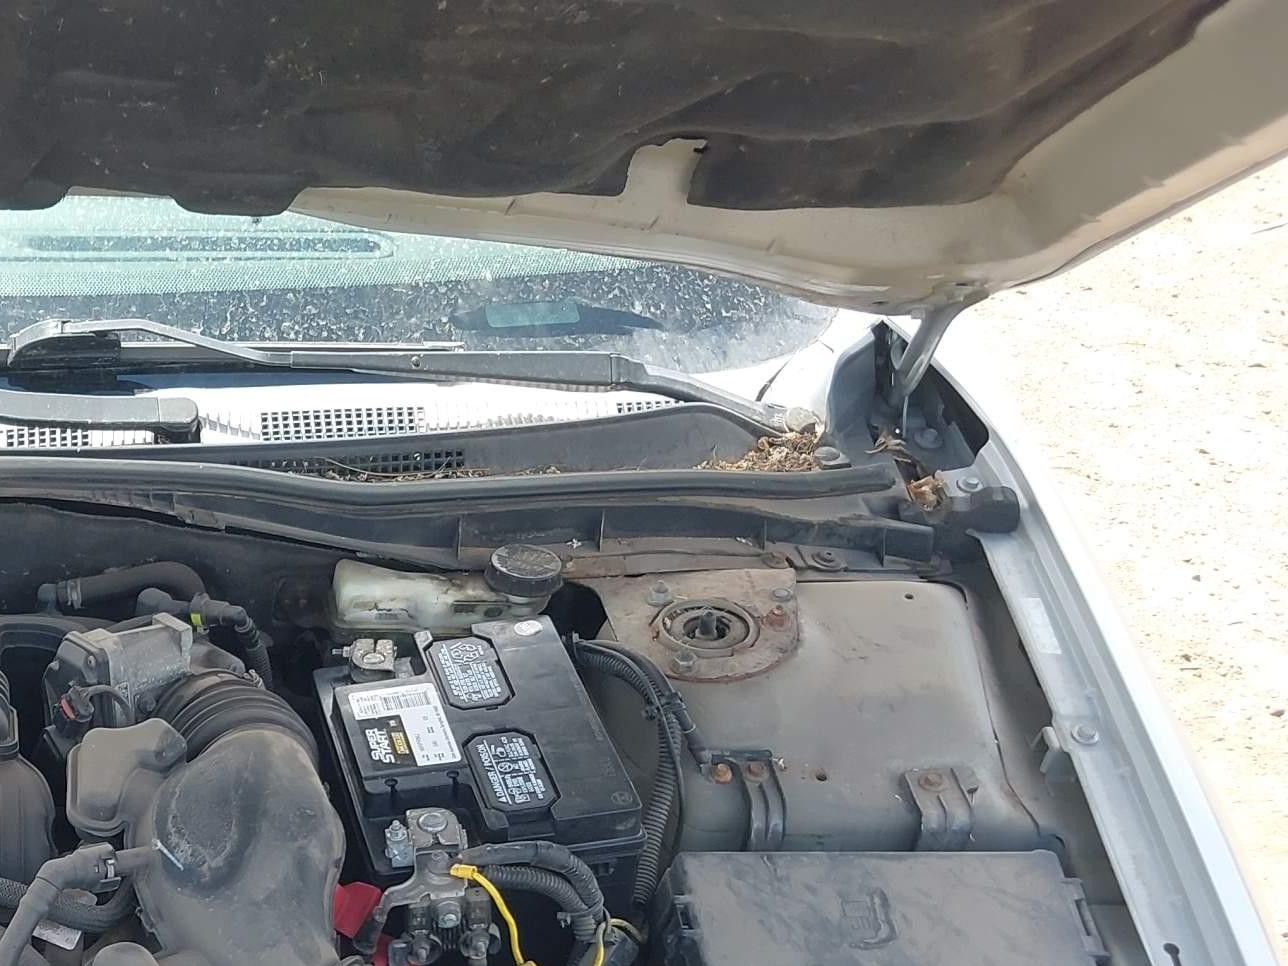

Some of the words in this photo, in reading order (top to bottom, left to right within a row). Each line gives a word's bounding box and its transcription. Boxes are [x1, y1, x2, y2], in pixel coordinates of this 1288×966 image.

[365, 728, 383, 761] SUPER
[376, 729, 396, 763] START
[476, 744, 493, 767] POISON
[488, 771, 505, 797] DANGER
